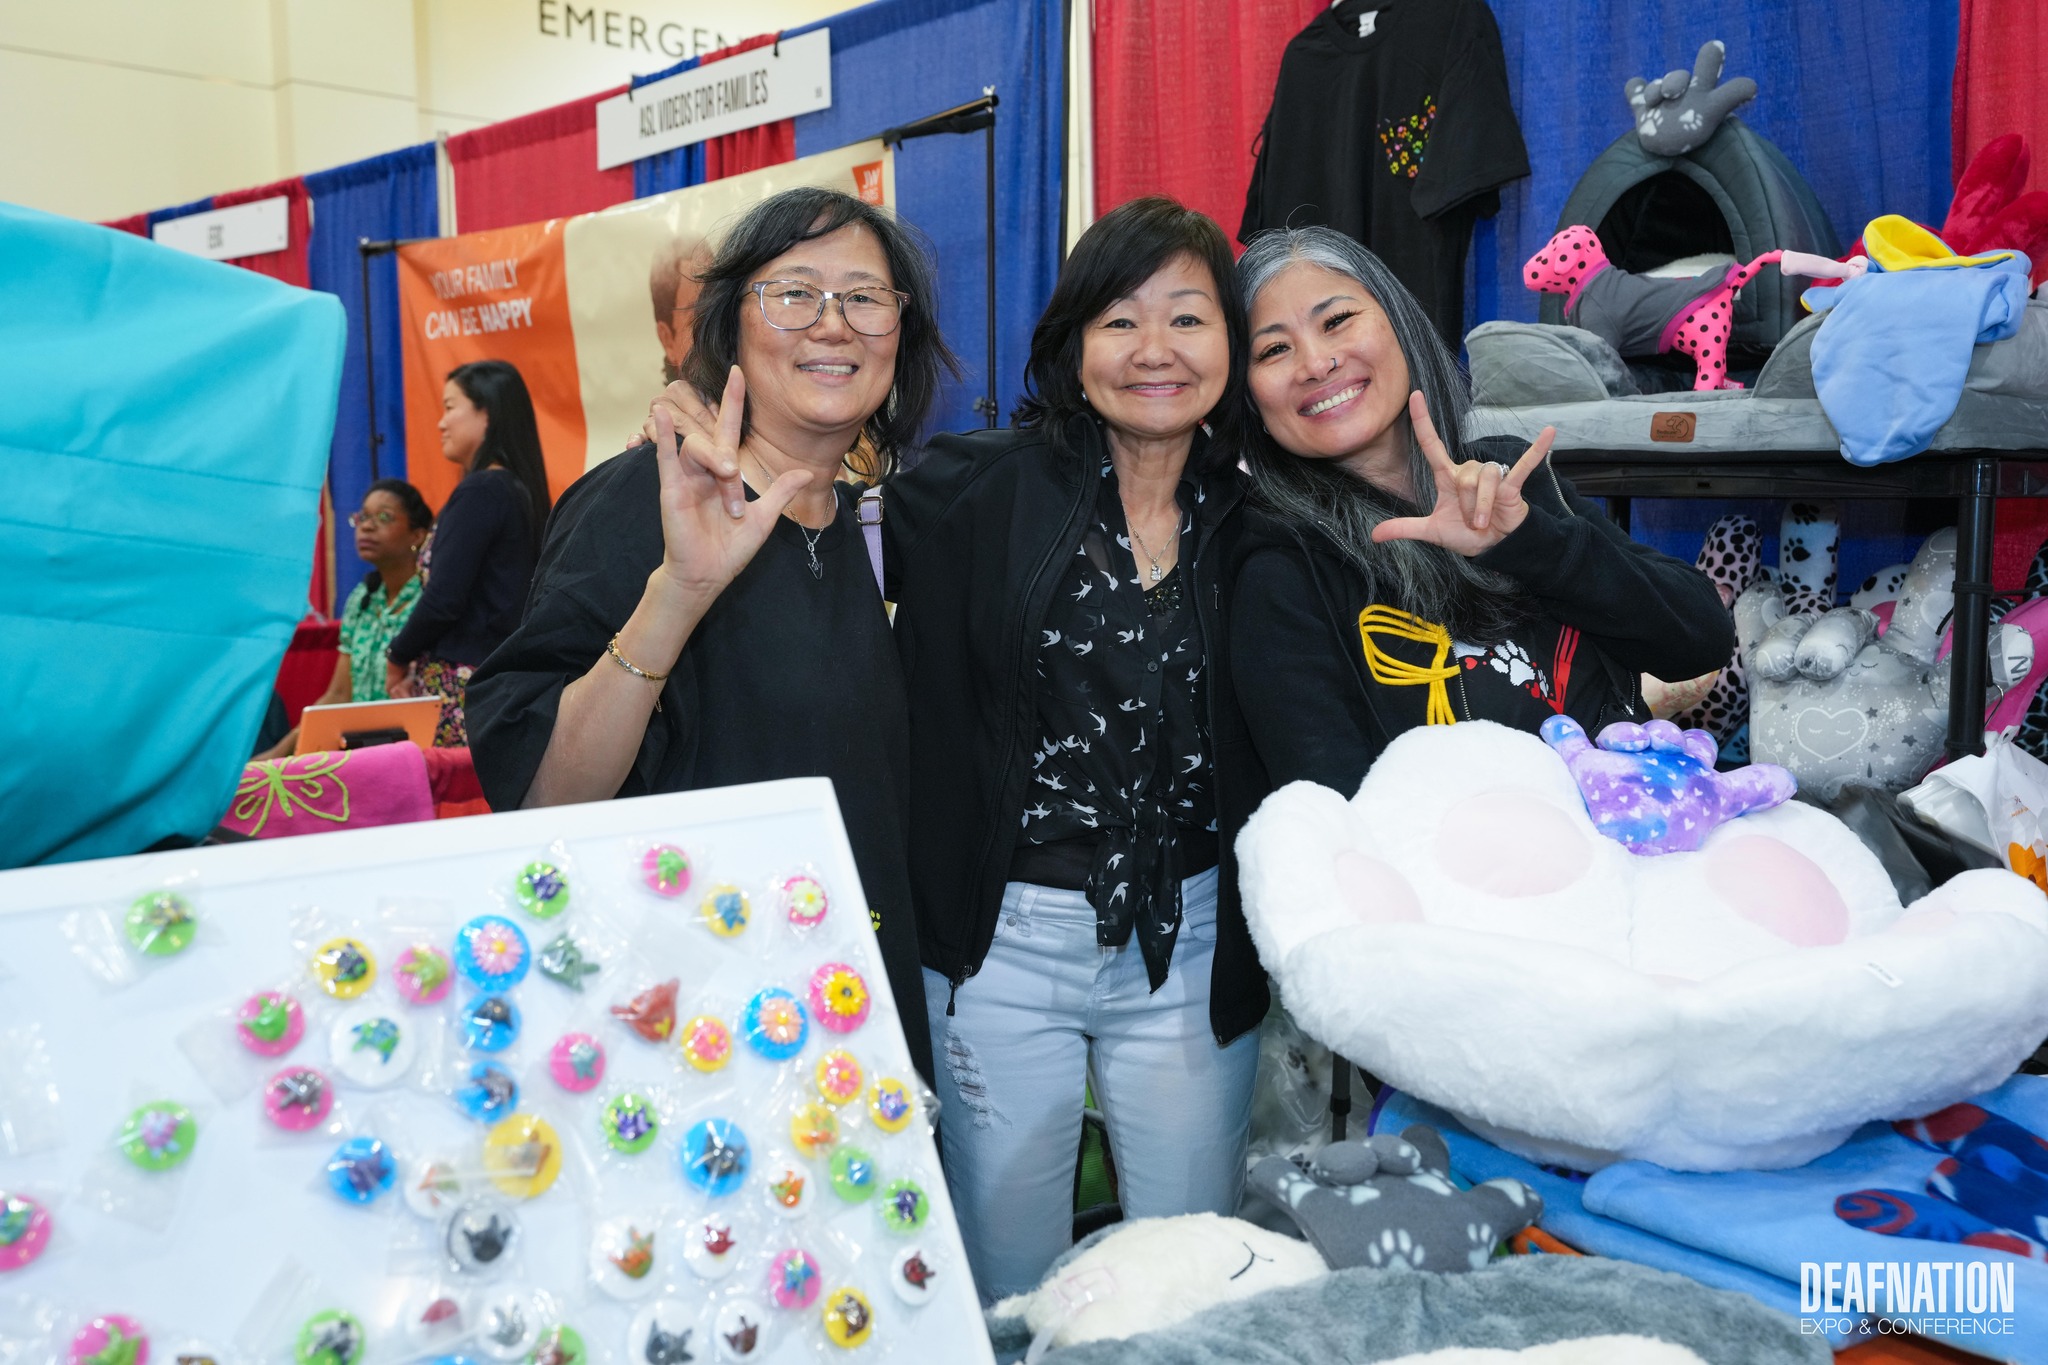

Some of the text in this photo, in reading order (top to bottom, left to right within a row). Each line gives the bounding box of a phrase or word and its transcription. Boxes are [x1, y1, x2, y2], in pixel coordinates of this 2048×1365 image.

[639, 68, 769, 139] ASL VIDEOS FOR FAMILIES
[427, 257, 519, 300] YOUR FAMILY
[424, 296, 533, 340] CAN BE HAPPY
